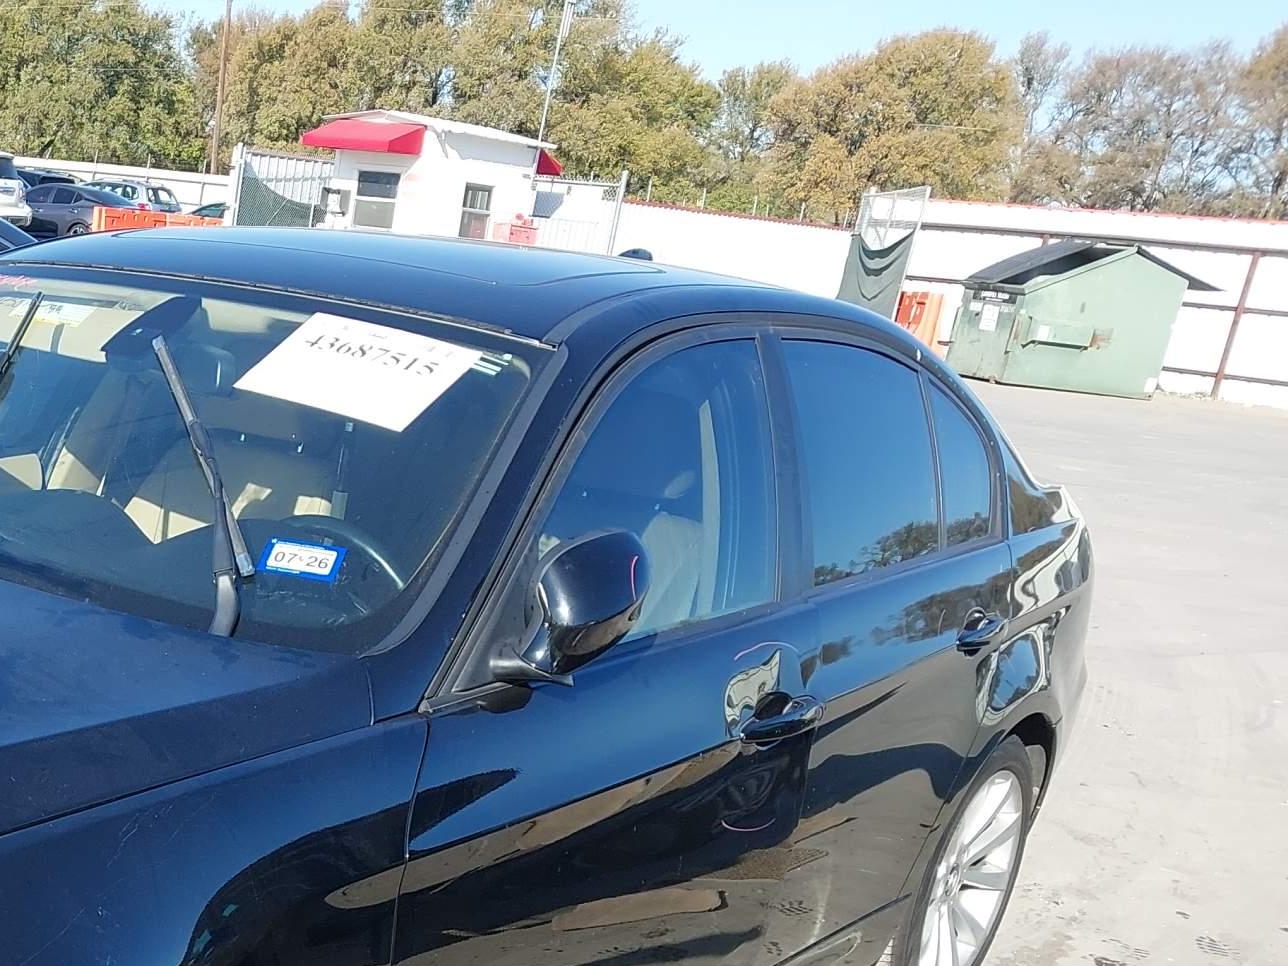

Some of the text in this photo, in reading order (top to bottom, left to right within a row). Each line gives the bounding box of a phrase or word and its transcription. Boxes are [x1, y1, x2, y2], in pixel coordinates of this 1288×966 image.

[306, 335, 439, 375] 43687515
[274, 551, 298, 564] 07
[306, 555, 330, 569] 26
